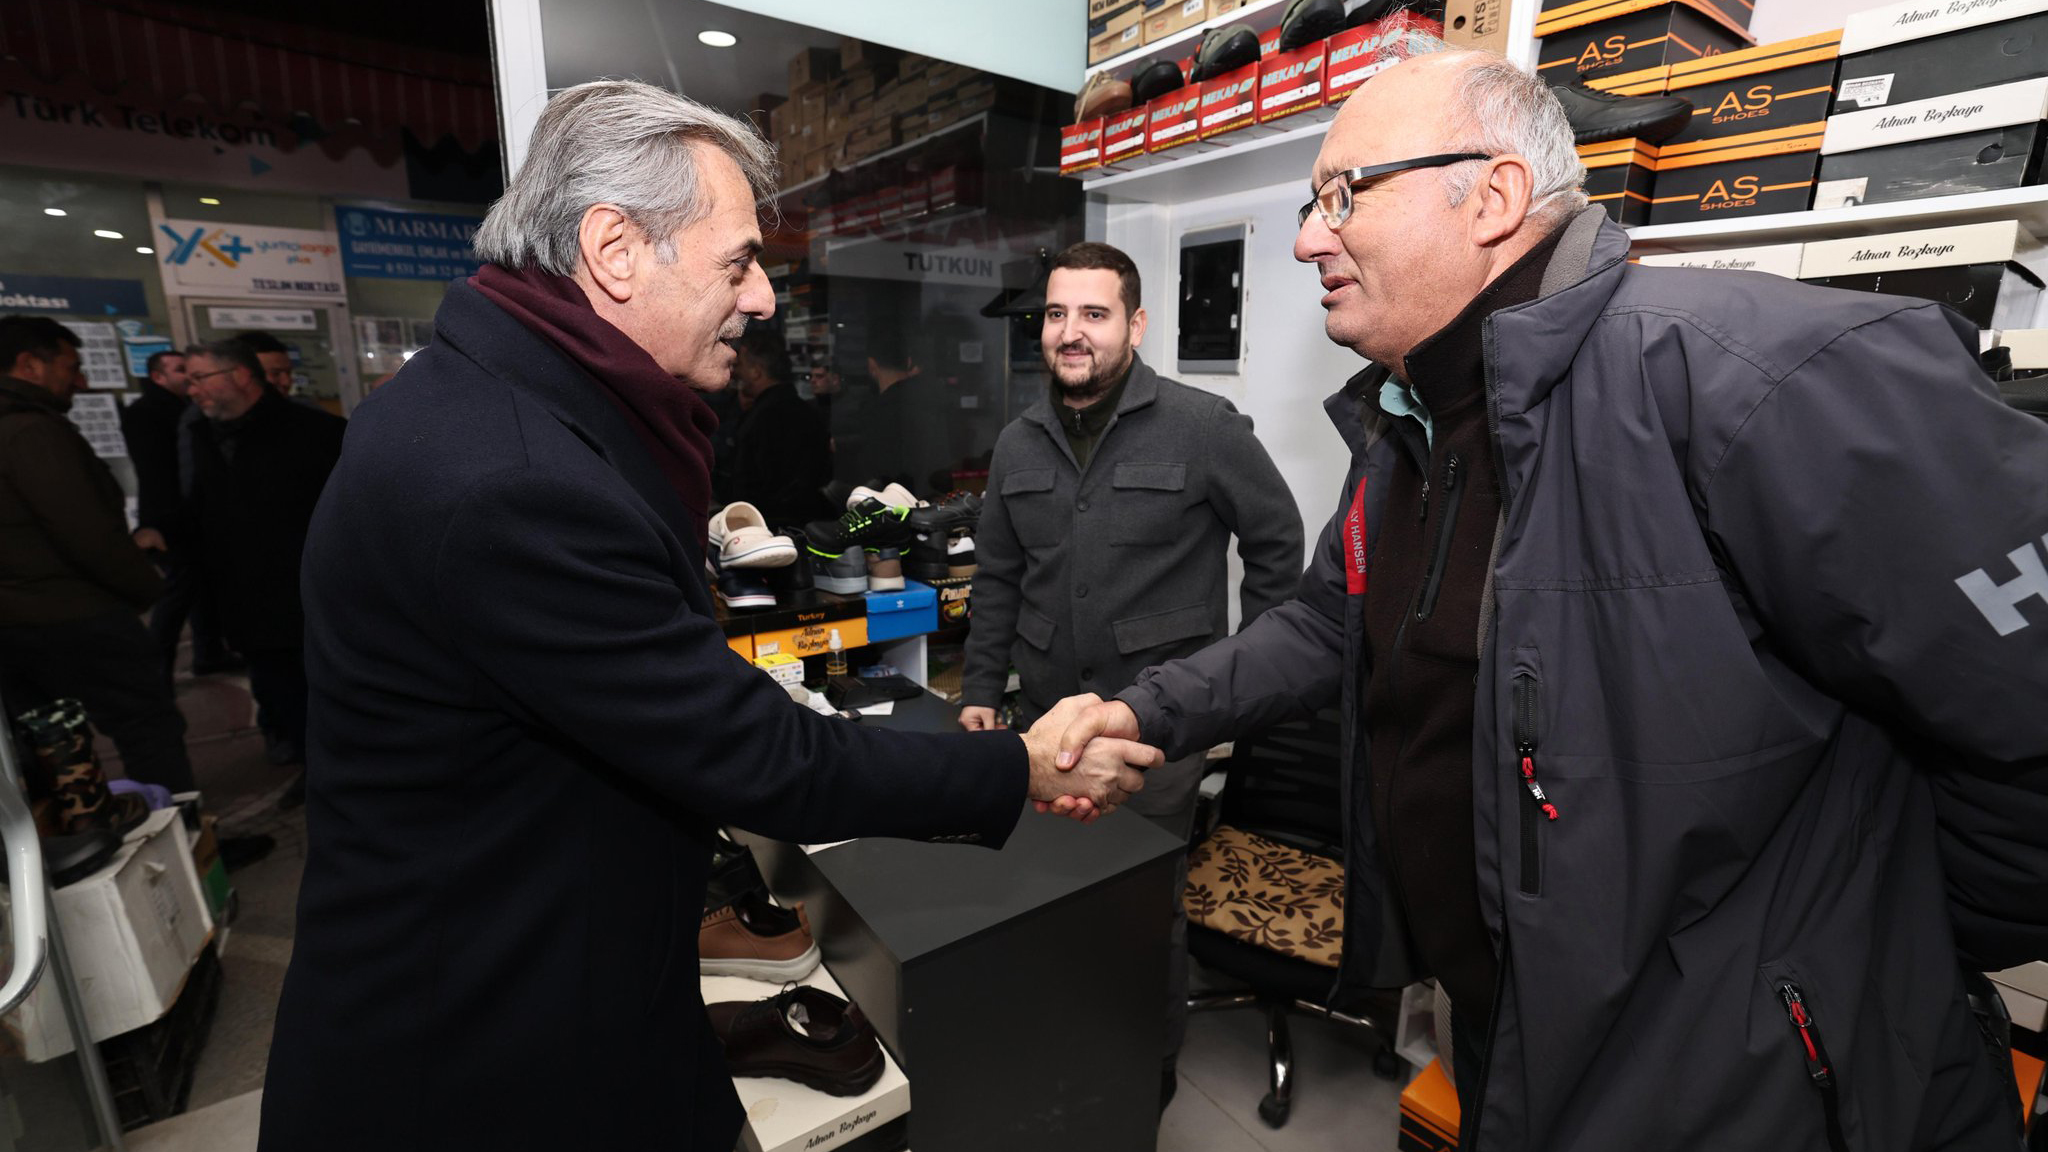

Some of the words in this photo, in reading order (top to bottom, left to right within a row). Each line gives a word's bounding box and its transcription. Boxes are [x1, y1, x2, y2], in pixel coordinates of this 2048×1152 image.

[1474, 2, 1486, 34] ATS
[1893, 9, 1940, 27] Adnan
[1330, 36, 1382, 65] MEKAP
[1577, 35, 1625, 65] AS
[1261, 61, 1304, 88] MEKAP
[1201, 83, 1239, 107] MEKAP
[1712, 85, 1773, 117] AS
[5, 89, 103, 128] Türk
[116, 103, 277, 148] Telekom
[1152, 102, 1184, 123] MEKAP
[1711, 108, 1770, 124] SHOES
[1872, 115, 1917, 130] Adnan
[1923, 104, 1984, 123] Bozkaya
[1105, 118, 1133, 136] MEKAP
[1700, 175, 1760, 204] AS
[1699, 198, 1757, 211] SHOES
[903, 252, 993, 278] TUTKUN
[1848, 249, 1892, 262] Adnan
[1897, 243, 1955, 260] Bozkaya
[1350, 524, 1367, 574] HANSEN
[803, 1131, 835, 1151] Adnan
